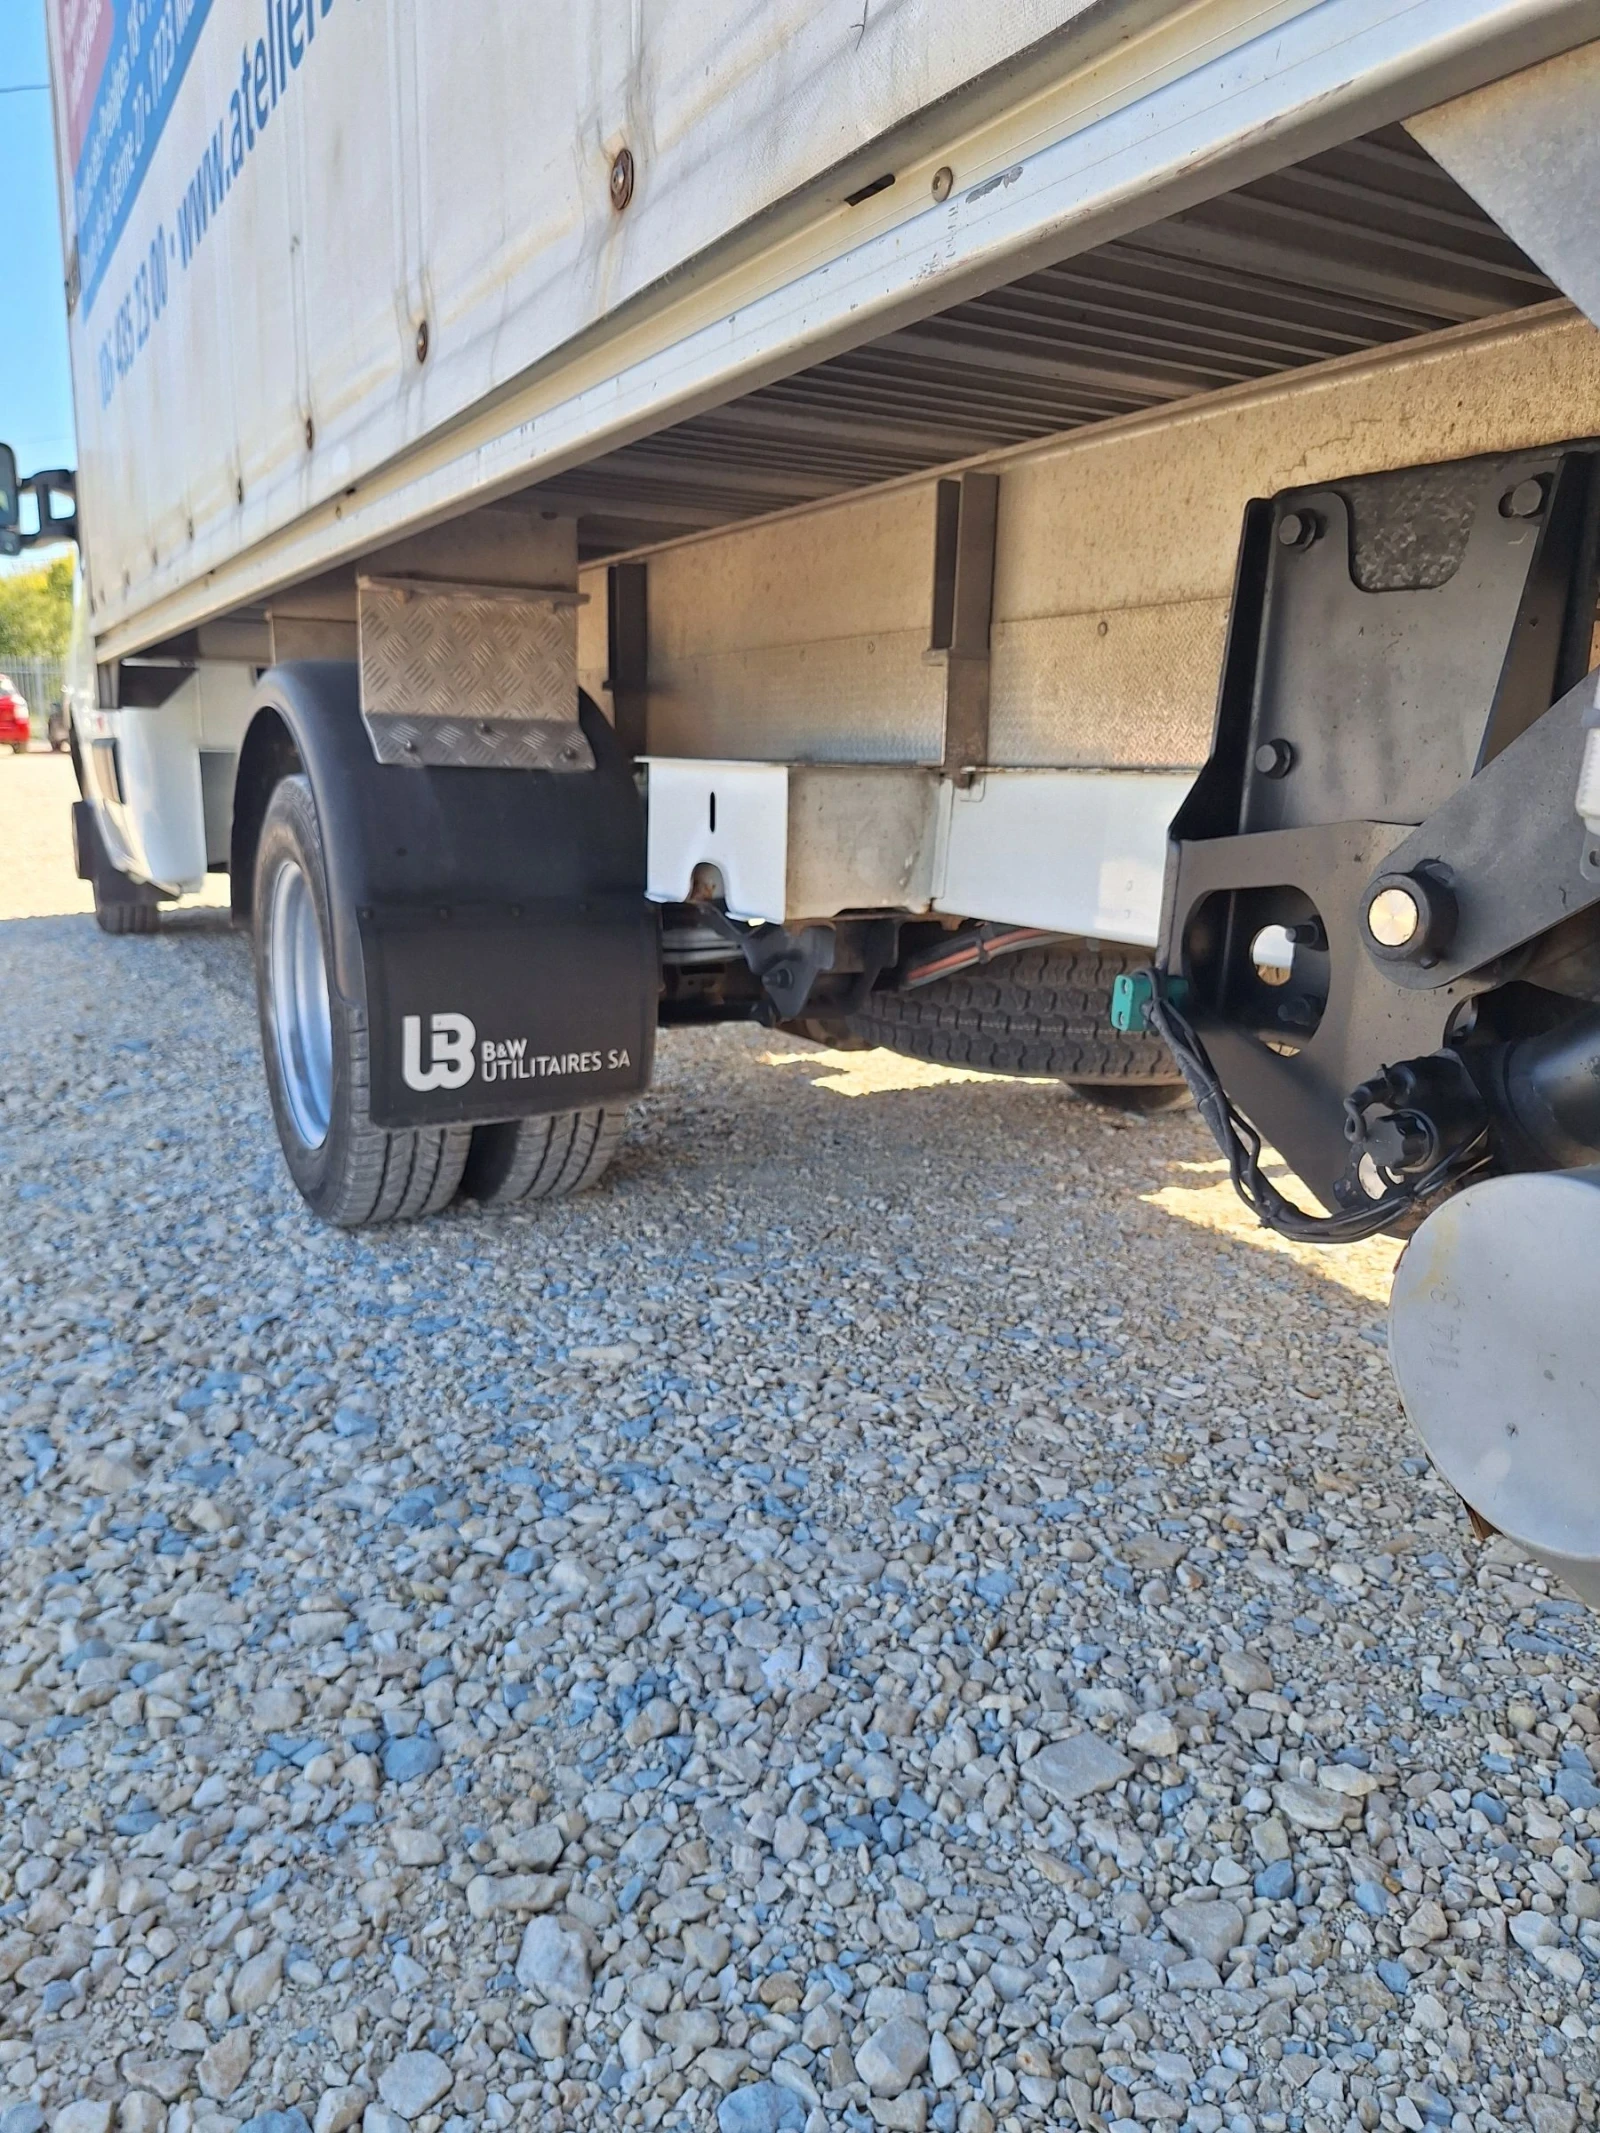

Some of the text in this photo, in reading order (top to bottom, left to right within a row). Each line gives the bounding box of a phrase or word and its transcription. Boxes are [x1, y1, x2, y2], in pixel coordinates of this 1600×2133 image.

[481, 1038, 528, 1062] B&W
[482, 1048, 632, 1083] UTILITAIRES SA
